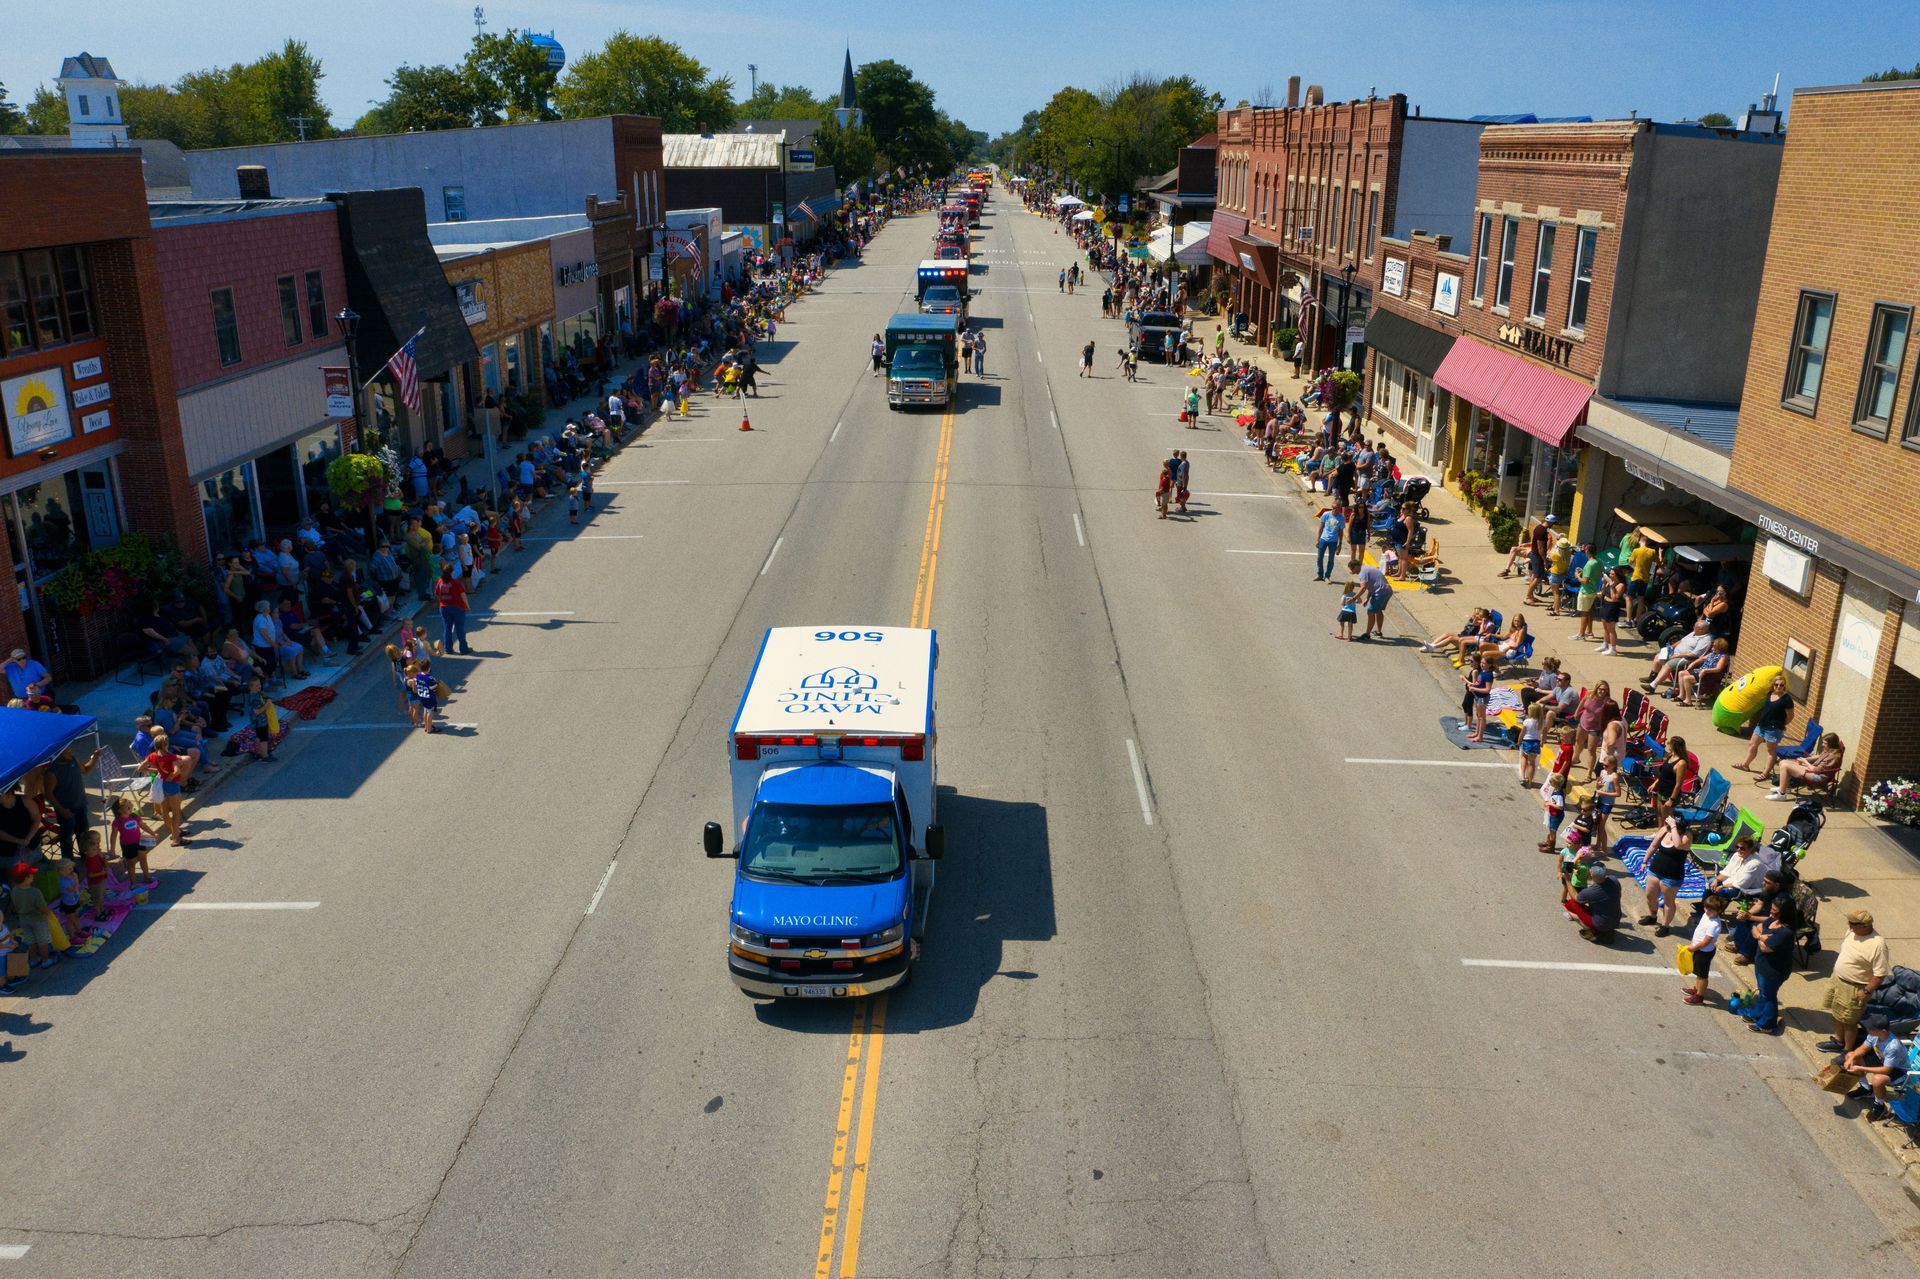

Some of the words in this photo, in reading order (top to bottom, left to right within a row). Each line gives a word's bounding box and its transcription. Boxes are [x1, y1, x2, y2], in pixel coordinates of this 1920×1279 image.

[1523, 328, 1574, 367] REALTY
[76, 361, 98, 375] Wreaths
[1758, 514, 1788, 538] FITNESS
[1788, 528, 1819, 553] CENTER
[815, 631, 884, 642] 506
[417, 684, 430, 698] 22
[778, 692, 892, 703] CLINIC
[784, 703, 884, 714] MAYO
[773, 915, 811, 926] MAYO
[813, 915, 859, 926] CLINIC
